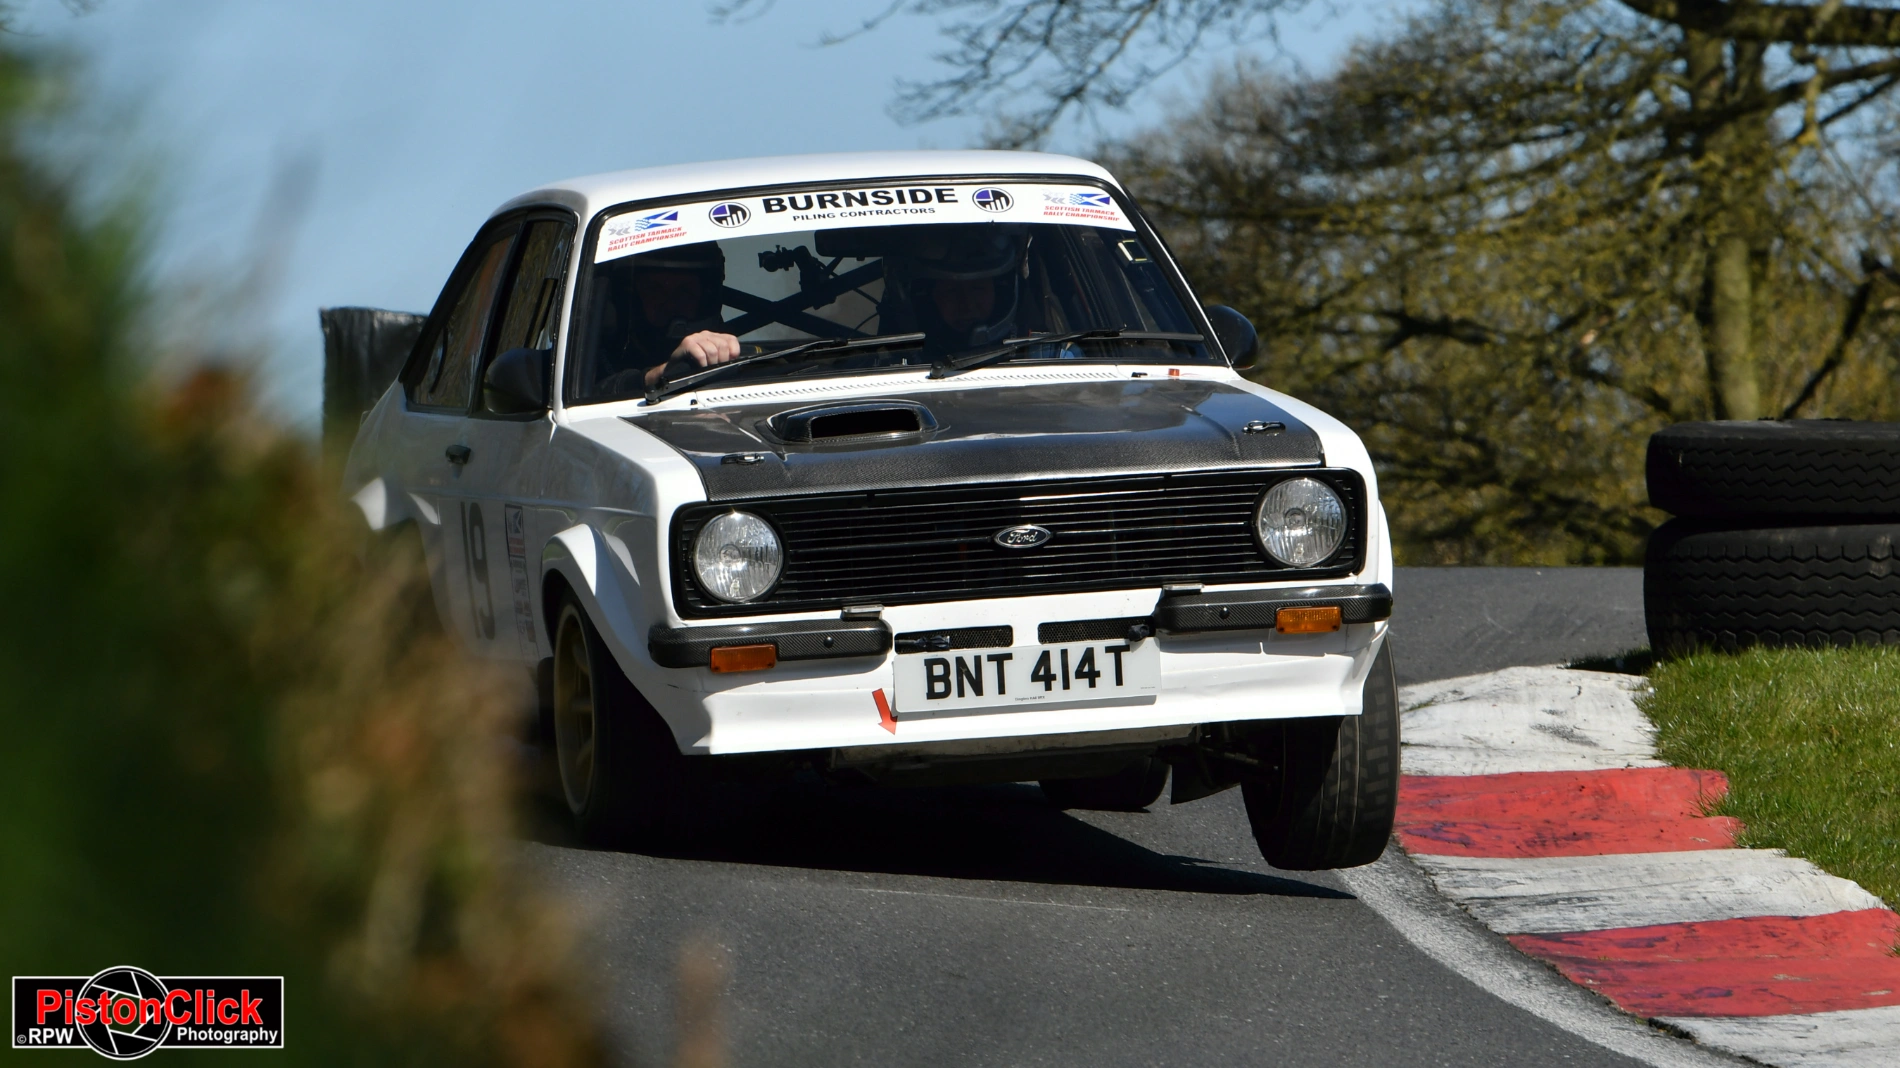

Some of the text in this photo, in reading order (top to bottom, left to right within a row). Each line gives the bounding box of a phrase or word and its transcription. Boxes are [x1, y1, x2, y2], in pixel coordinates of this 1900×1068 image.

[762, 188, 959, 214] BURNSIDE
[792, 207, 936, 222] PILING CONTRACTORS
[1044, 205, 1116, 216] SCOTTISH TARMACK
[1065, 212, 1120, 222] CHAMPIONSHIP
[607, 231, 688, 252] RALLY CHAMPIONSHIP
[609, 226, 683, 246] SCOTTISH TARMACK
[1007, 529, 1038, 544] Ford
[924, 644, 1131, 700] BNT 414T
